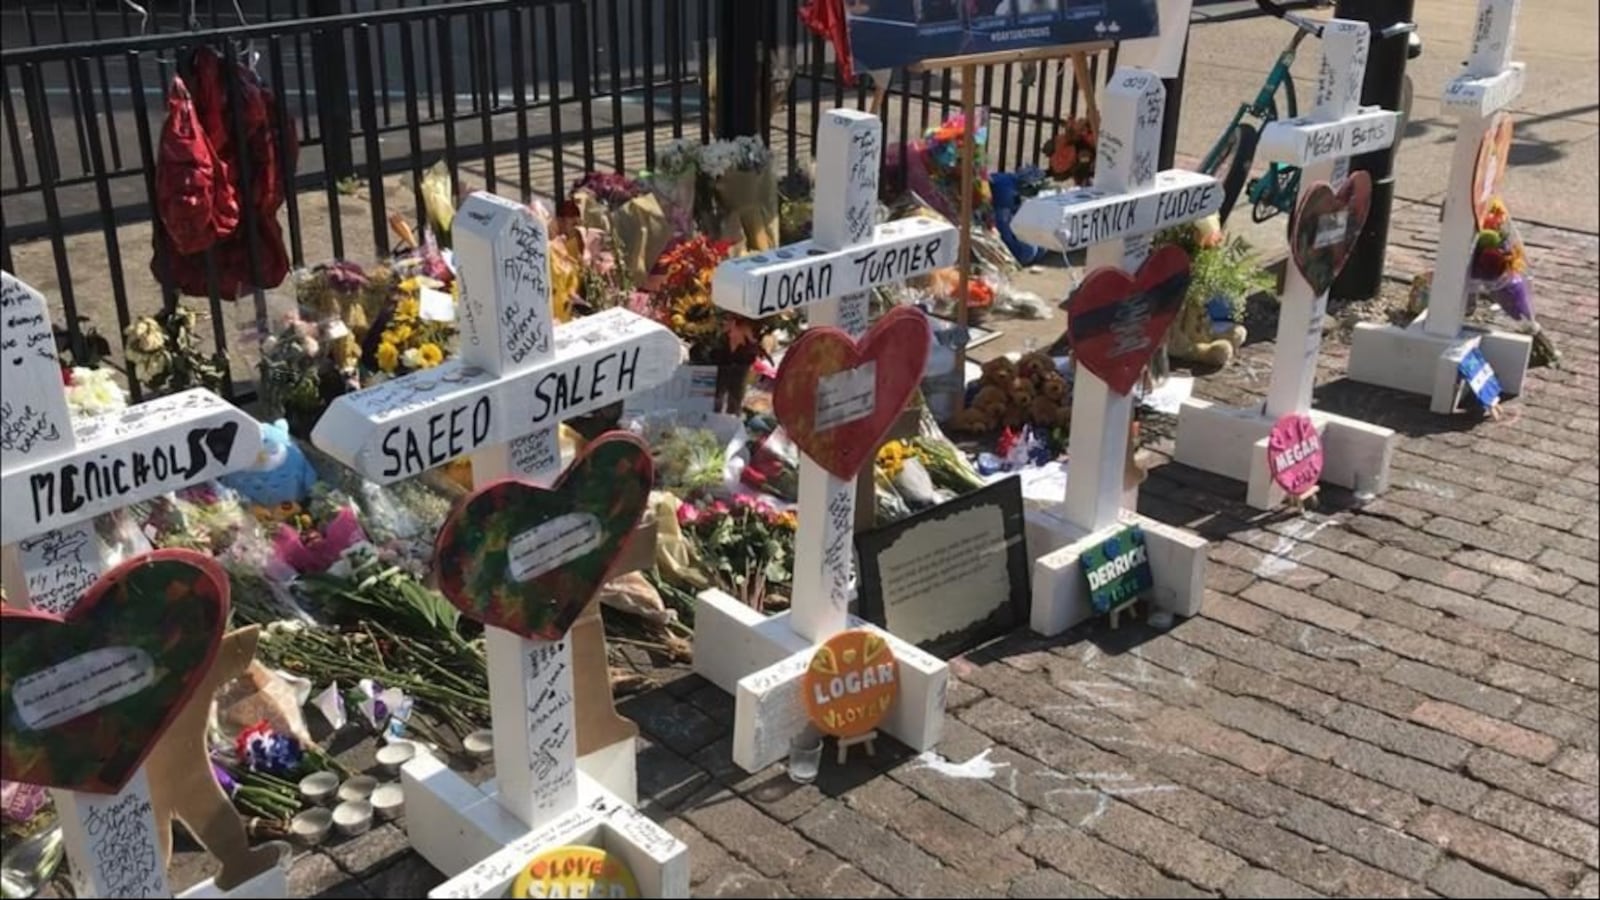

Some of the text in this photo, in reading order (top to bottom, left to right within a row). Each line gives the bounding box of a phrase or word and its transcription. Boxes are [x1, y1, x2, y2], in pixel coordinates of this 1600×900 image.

[1304, 127, 1345, 160] MEGAN
[1068, 198, 1138, 248] DERRICK
[1155, 184, 1216, 225] FUDGE
[758, 263, 832, 316] LOGAN
[854, 237, 941, 287] TURNER
[382, 396, 491, 477] SAEED
[532, 346, 641, 423] SALEH
[1275, 434, 1319, 473] MEGAN
[1087, 545, 1147, 592] DERRICK
[814, 661, 895, 705] LOGAN
[550, 858, 603, 879] LOVE
